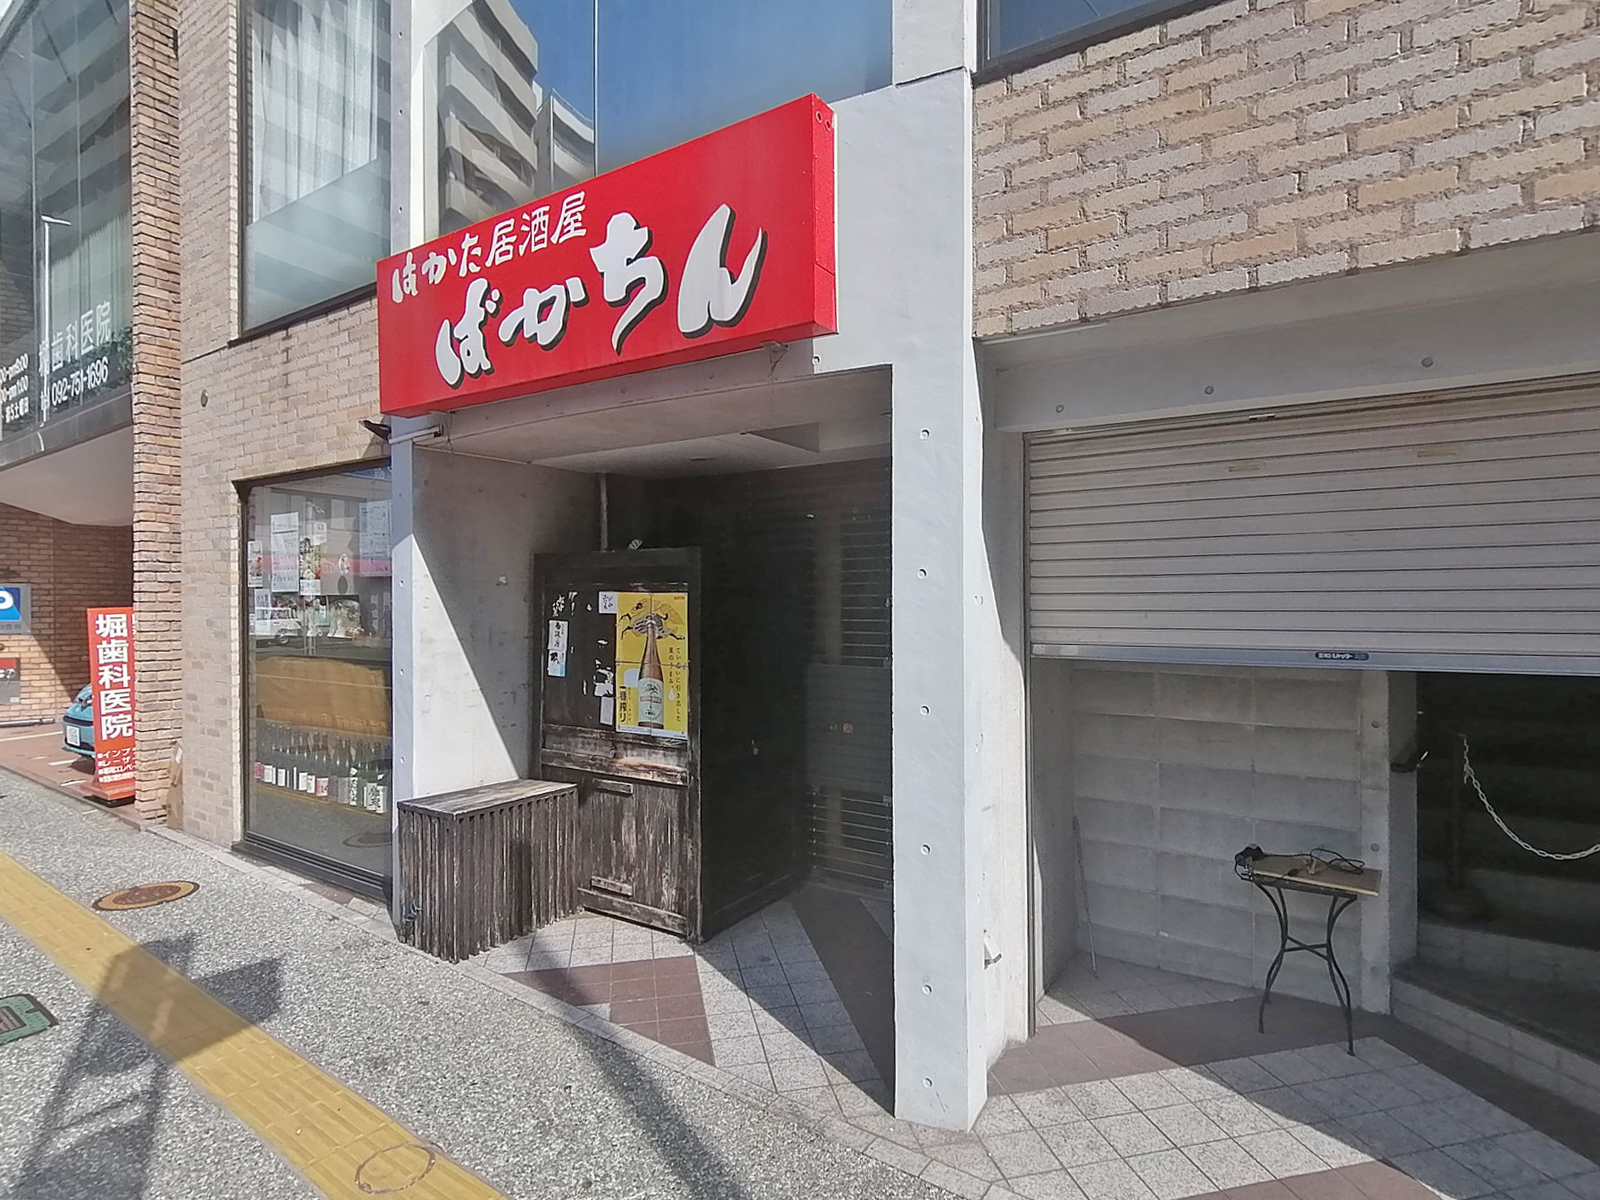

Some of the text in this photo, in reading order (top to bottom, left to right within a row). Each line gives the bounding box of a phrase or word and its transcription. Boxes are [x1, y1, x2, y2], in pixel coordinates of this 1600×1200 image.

[391, 191, 588, 304] はかた居酒屋
[434, 203, 767, 390] ばかちん
[51, 356, 109, 406] 092-751-1696
[95, 613, 133, 741] 堀歯科医院
